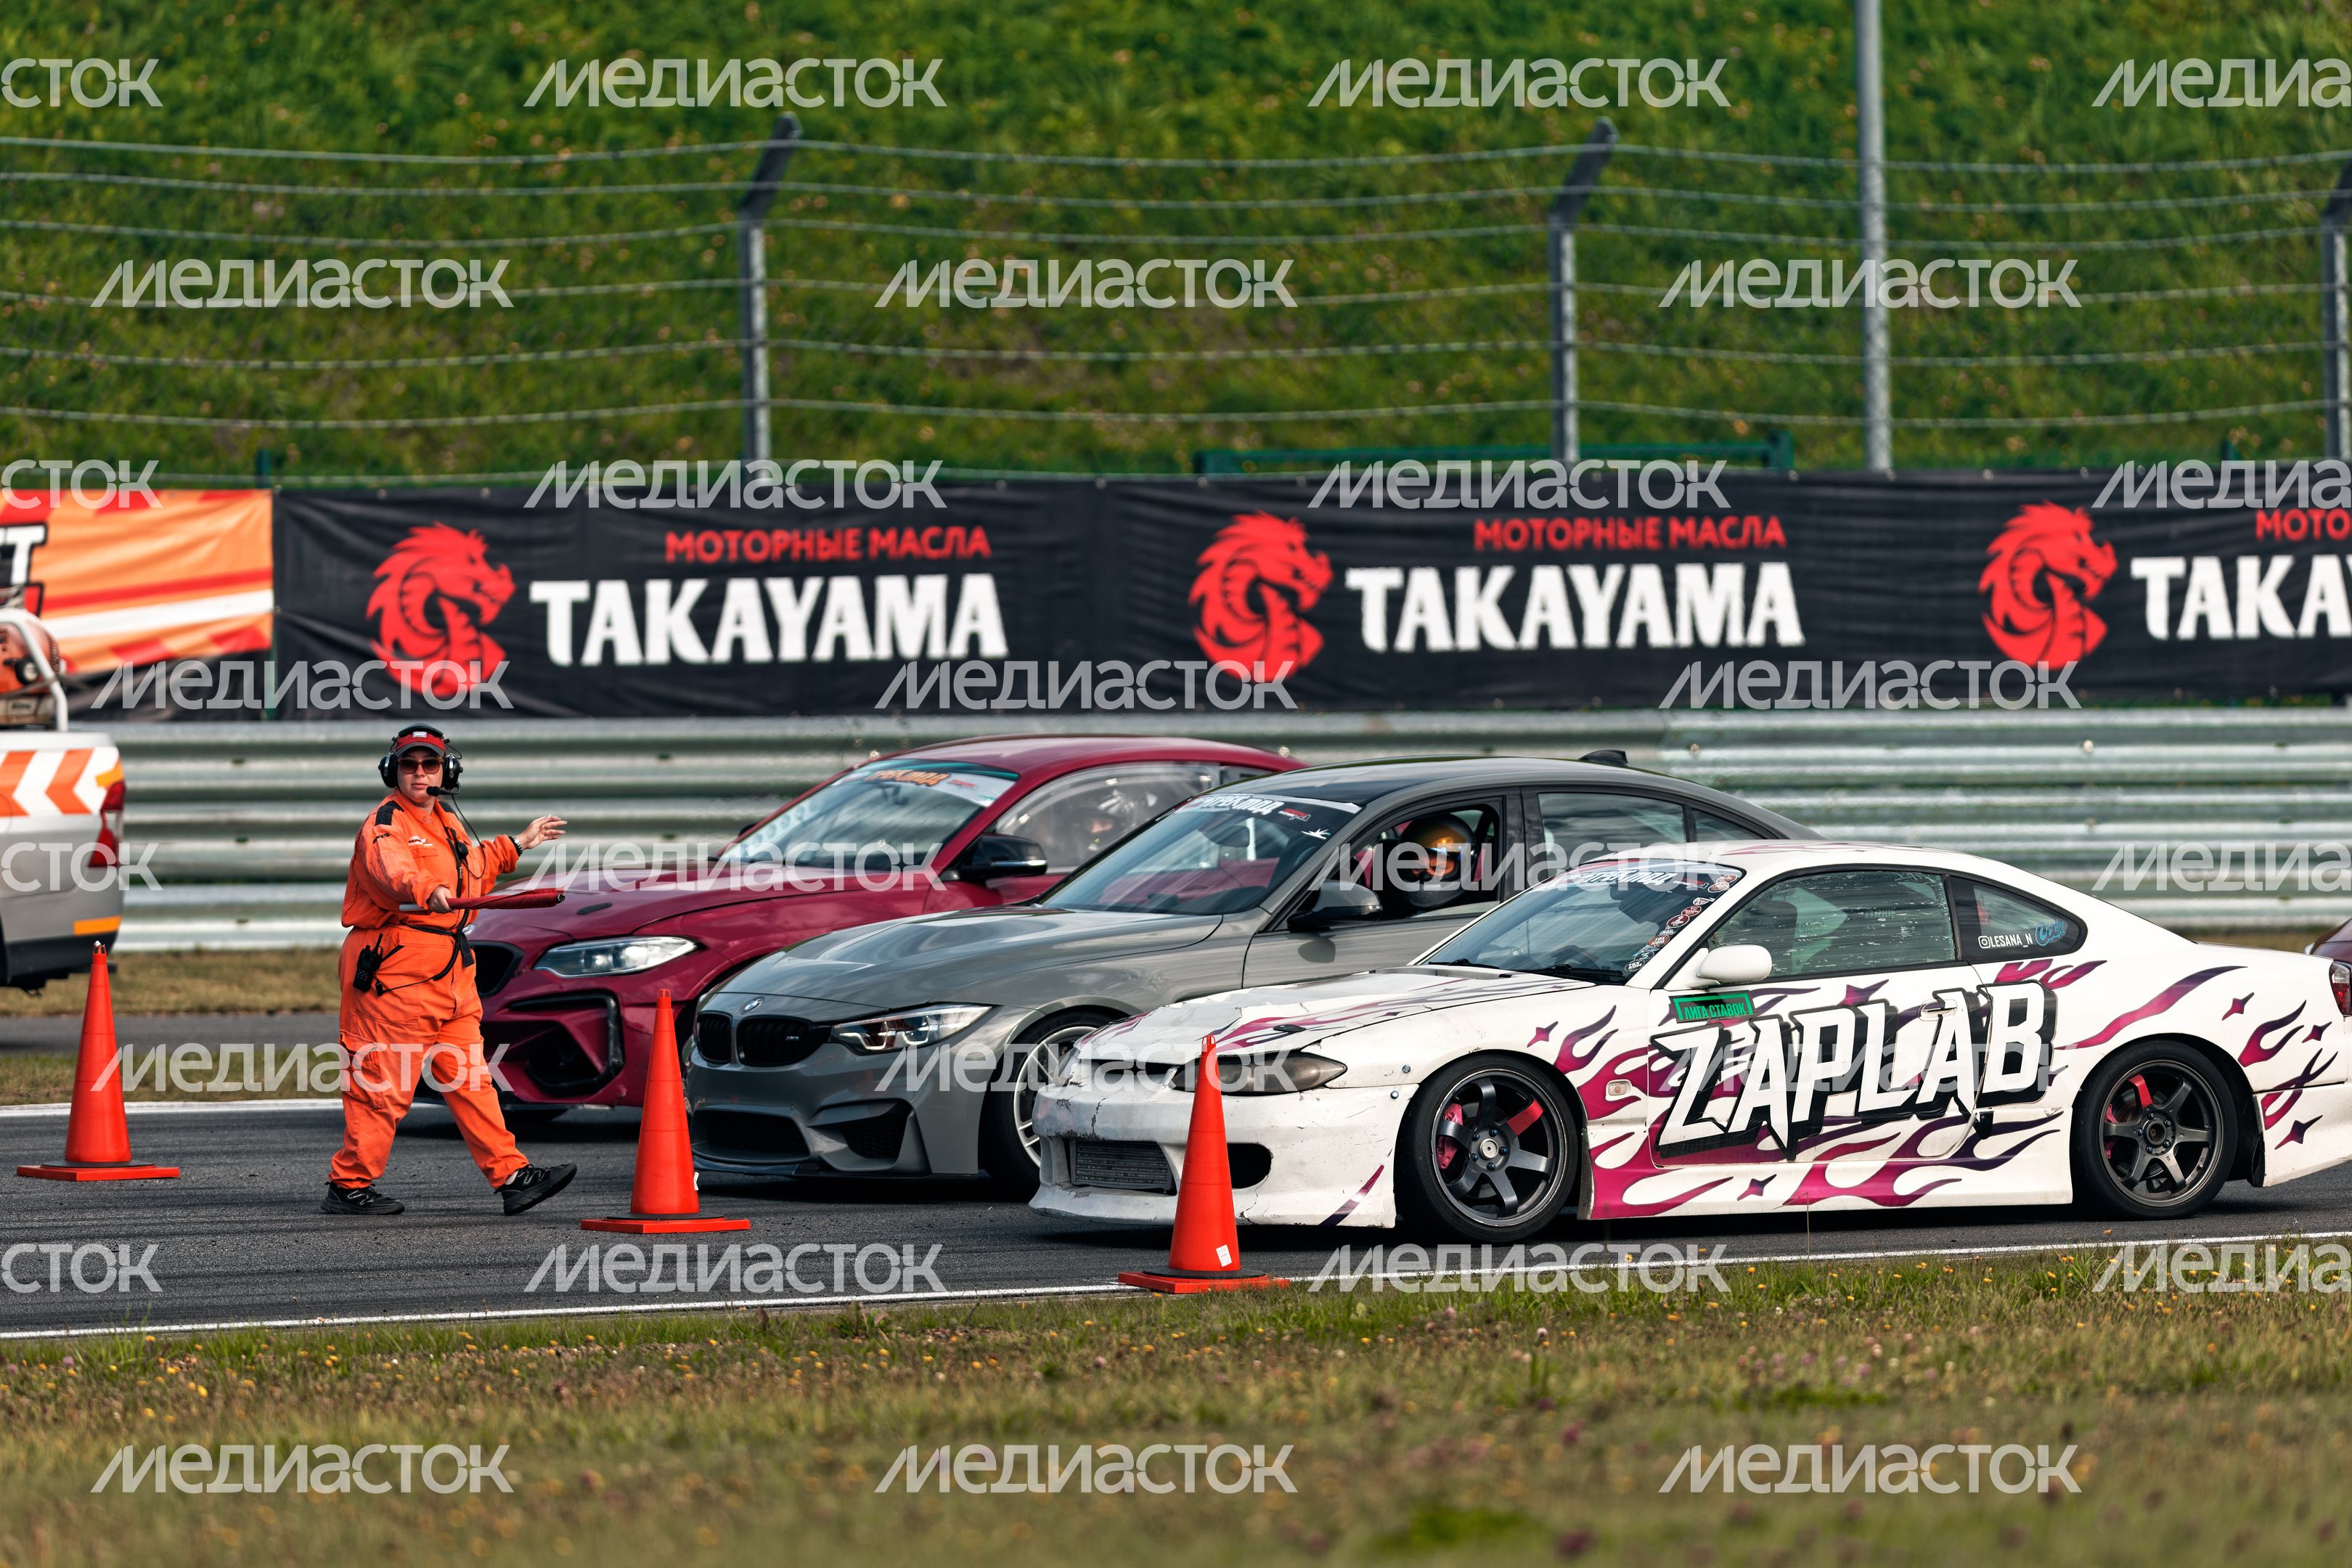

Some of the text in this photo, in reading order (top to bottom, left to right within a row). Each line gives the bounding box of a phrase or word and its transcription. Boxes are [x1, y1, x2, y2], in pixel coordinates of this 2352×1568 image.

[665, 526, 992, 563] МОТОРНЫЕ МАСЛА
[1474, 515, 1788, 552] МОТОРНЫЕ МАСЛА
[529, 573, 1008, 666] TAKAYAMA
[1344, 561, 1805, 653] TAKAYAMA
[2130, 553, 2352, 641] TAKA
[1685, 1002, 1747, 1020] ЛИГА СТАВОК
[1651, 981, 2054, 1159] ZAPLAB
